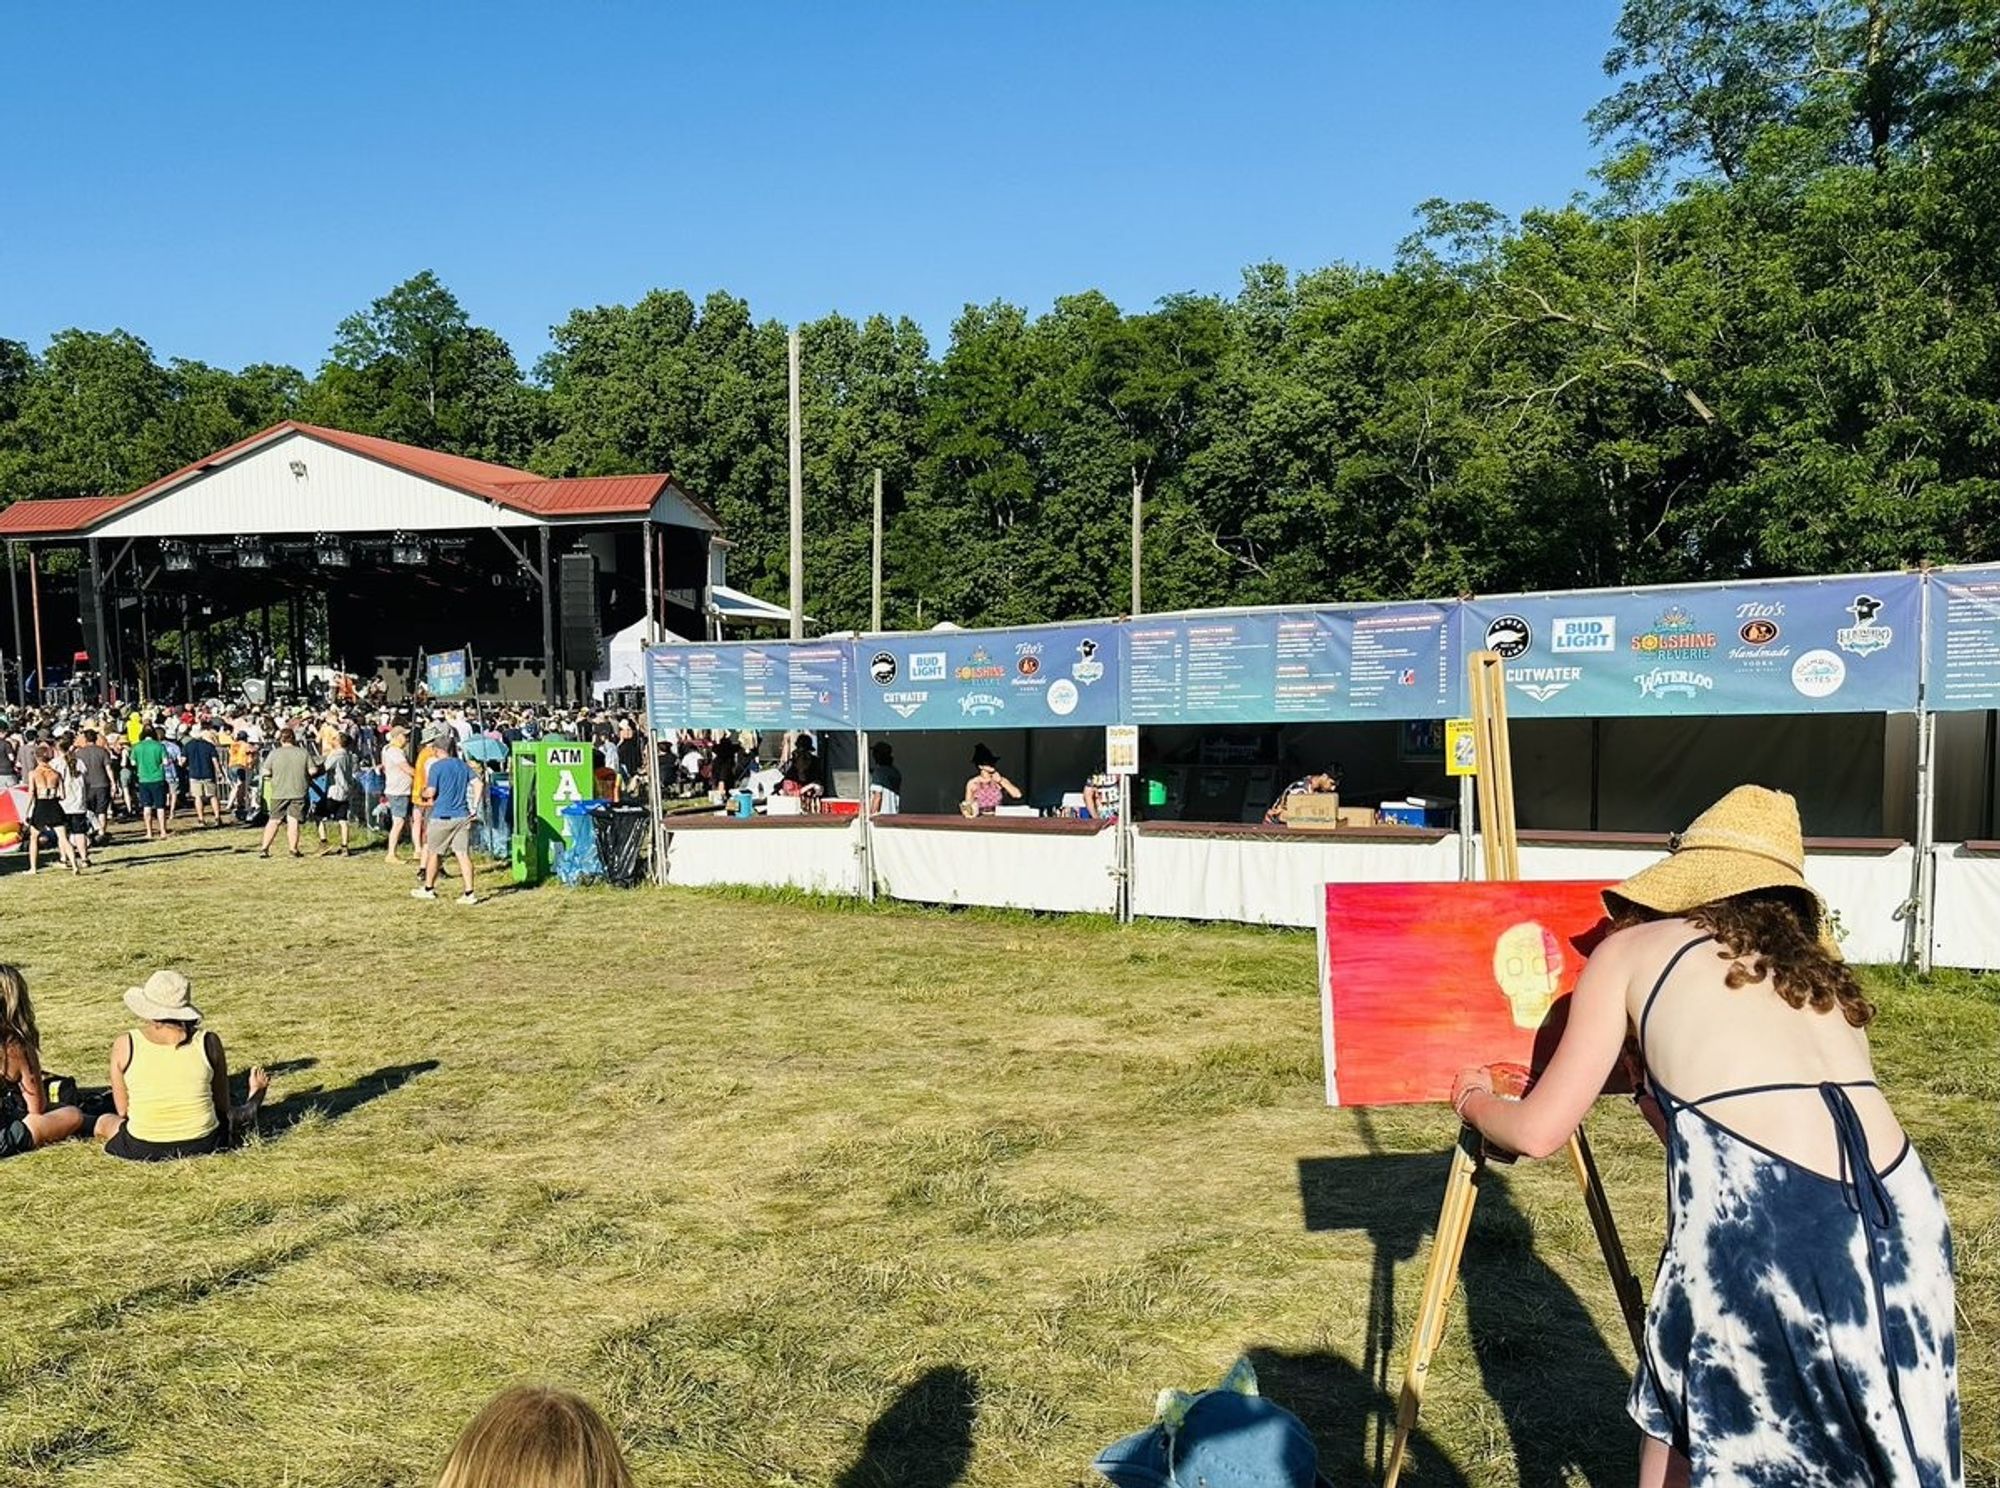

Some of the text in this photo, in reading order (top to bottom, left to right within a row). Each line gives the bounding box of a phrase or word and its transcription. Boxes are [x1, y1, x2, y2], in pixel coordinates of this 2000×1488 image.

[1735, 601, 1786, 618] Tito's
[1565, 622, 1603, 634] BUD
[1556, 634, 1610, 648] LIGHT
[1631, 633, 1717, 650] SOLSHINE
[1658, 648, 1710, 660] REVERIE
[1728, 645, 1791, 660] Handmade
[917, 656, 939, 666] BUD
[911, 667, 942, 677] LIGHT
[1506, 667, 1584, 682] CUTWATER
[549, 749, 582, 764] ATM
